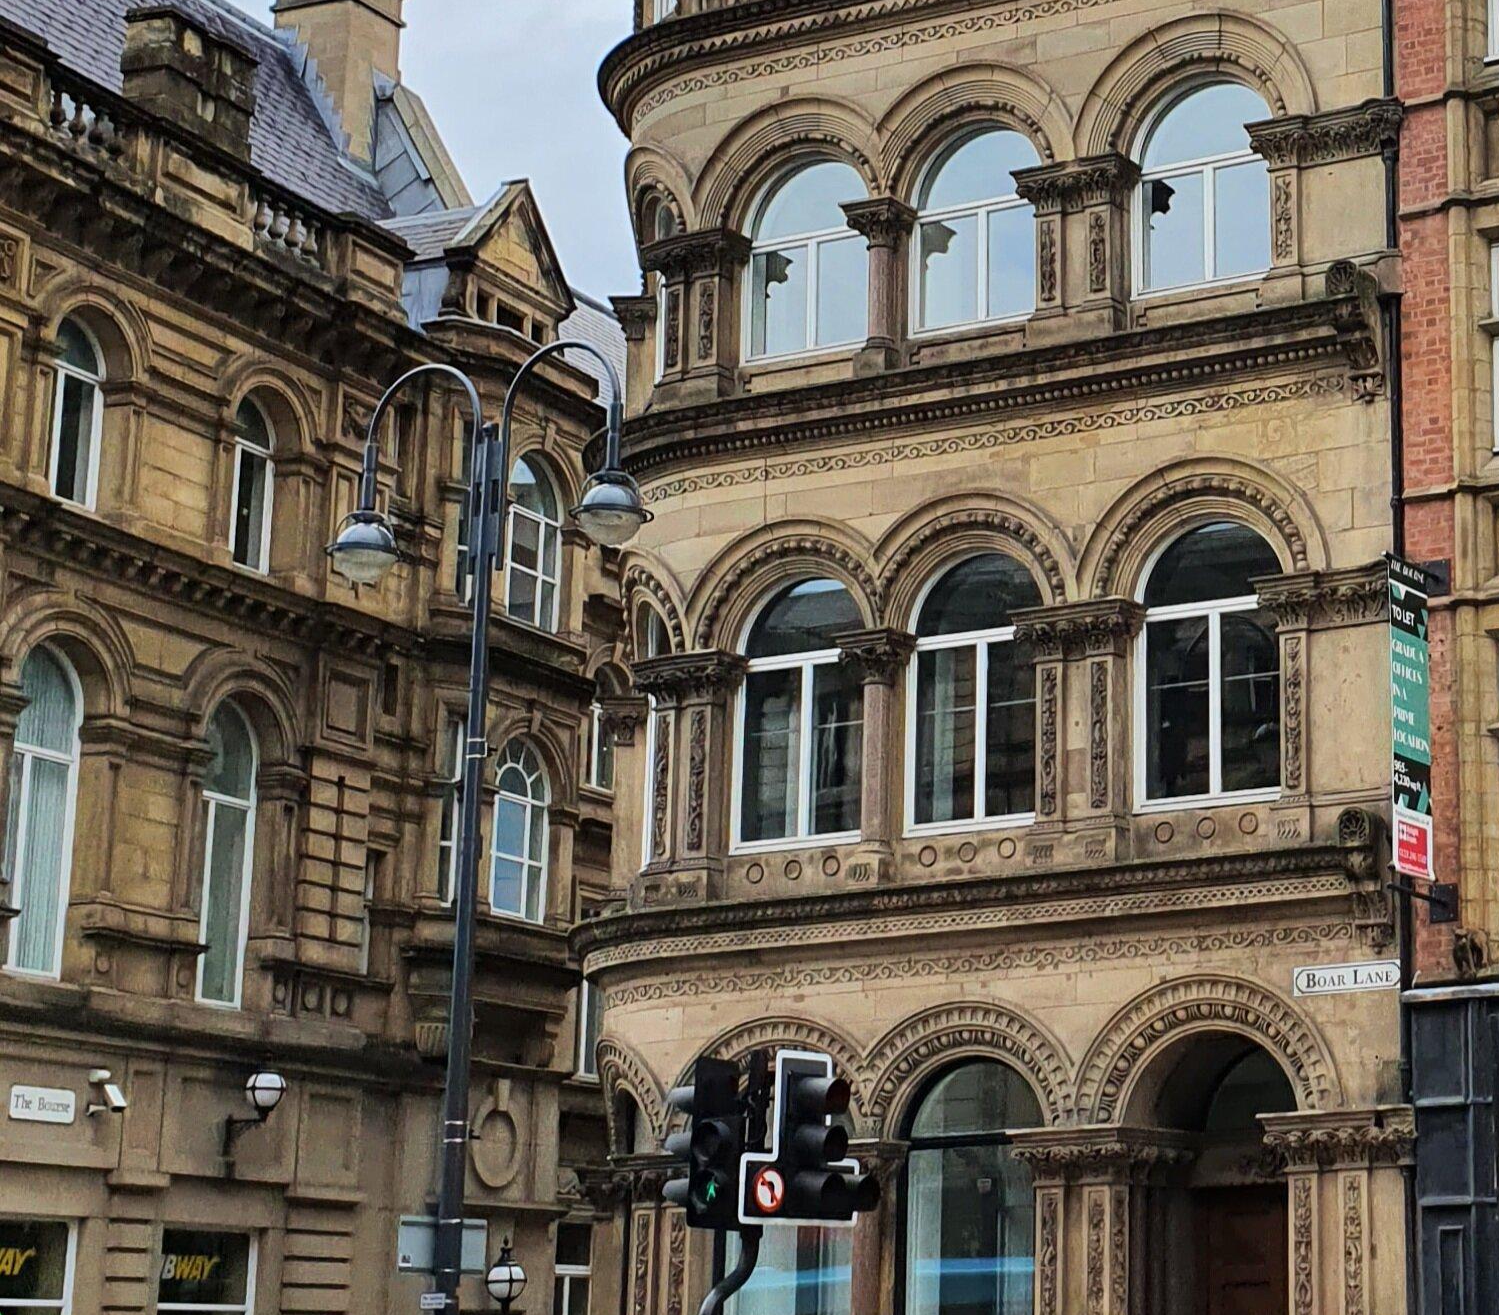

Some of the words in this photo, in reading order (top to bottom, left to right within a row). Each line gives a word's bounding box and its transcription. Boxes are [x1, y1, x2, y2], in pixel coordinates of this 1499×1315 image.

[1392, 604, 1402, 621] TO
[1403, 609, 1415, 627] LET
[1305, 971, 1347, 989] BOAR
[1351, 968, 1394, 986] LANE
[14, 1093, 33, 1110] The
[160, 1253, 220, 1281] BWAY
